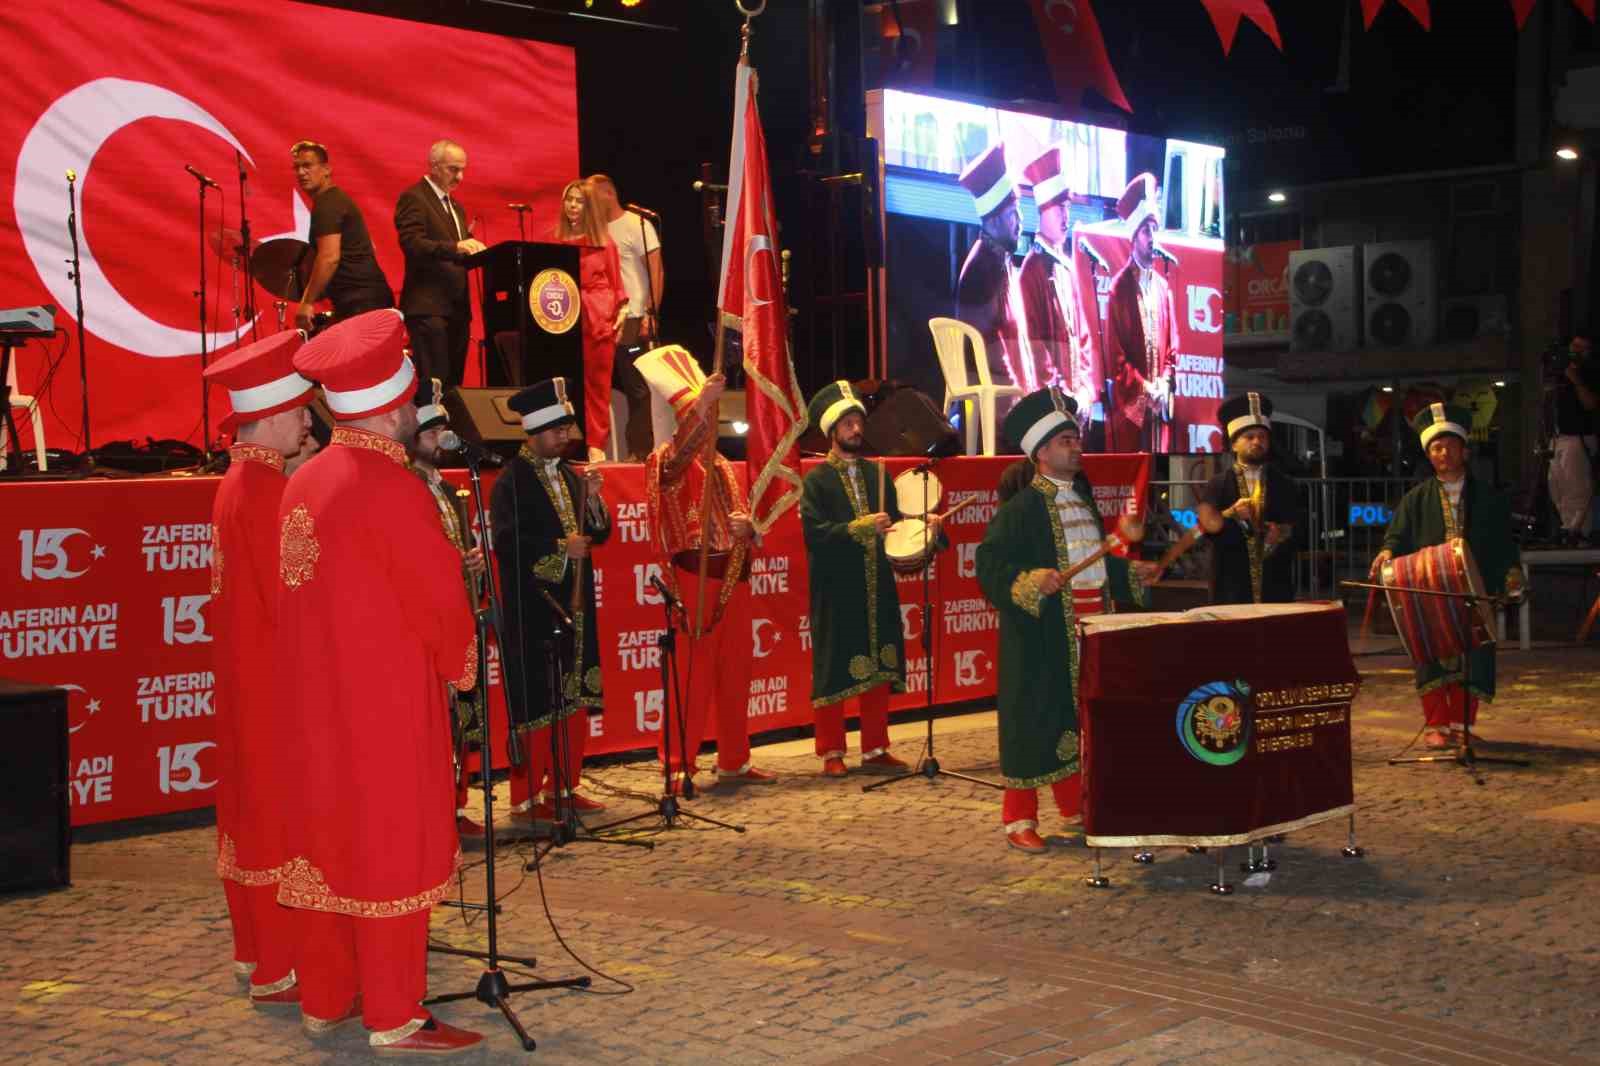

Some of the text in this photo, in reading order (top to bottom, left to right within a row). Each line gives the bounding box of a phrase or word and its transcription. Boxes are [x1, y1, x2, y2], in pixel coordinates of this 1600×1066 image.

[1351, 504, 1392, 525] POL
[18, 528, 83, 580] 15
[142, 543, 216, 572] TÜRK
[161, 594, 212, 645] 15
[954, 650, 984, 687] 15
[137, 690, 216, 723] TÜRK
[76, 755, 113, 778] ADI
[156, 741, 211, 794] 15
